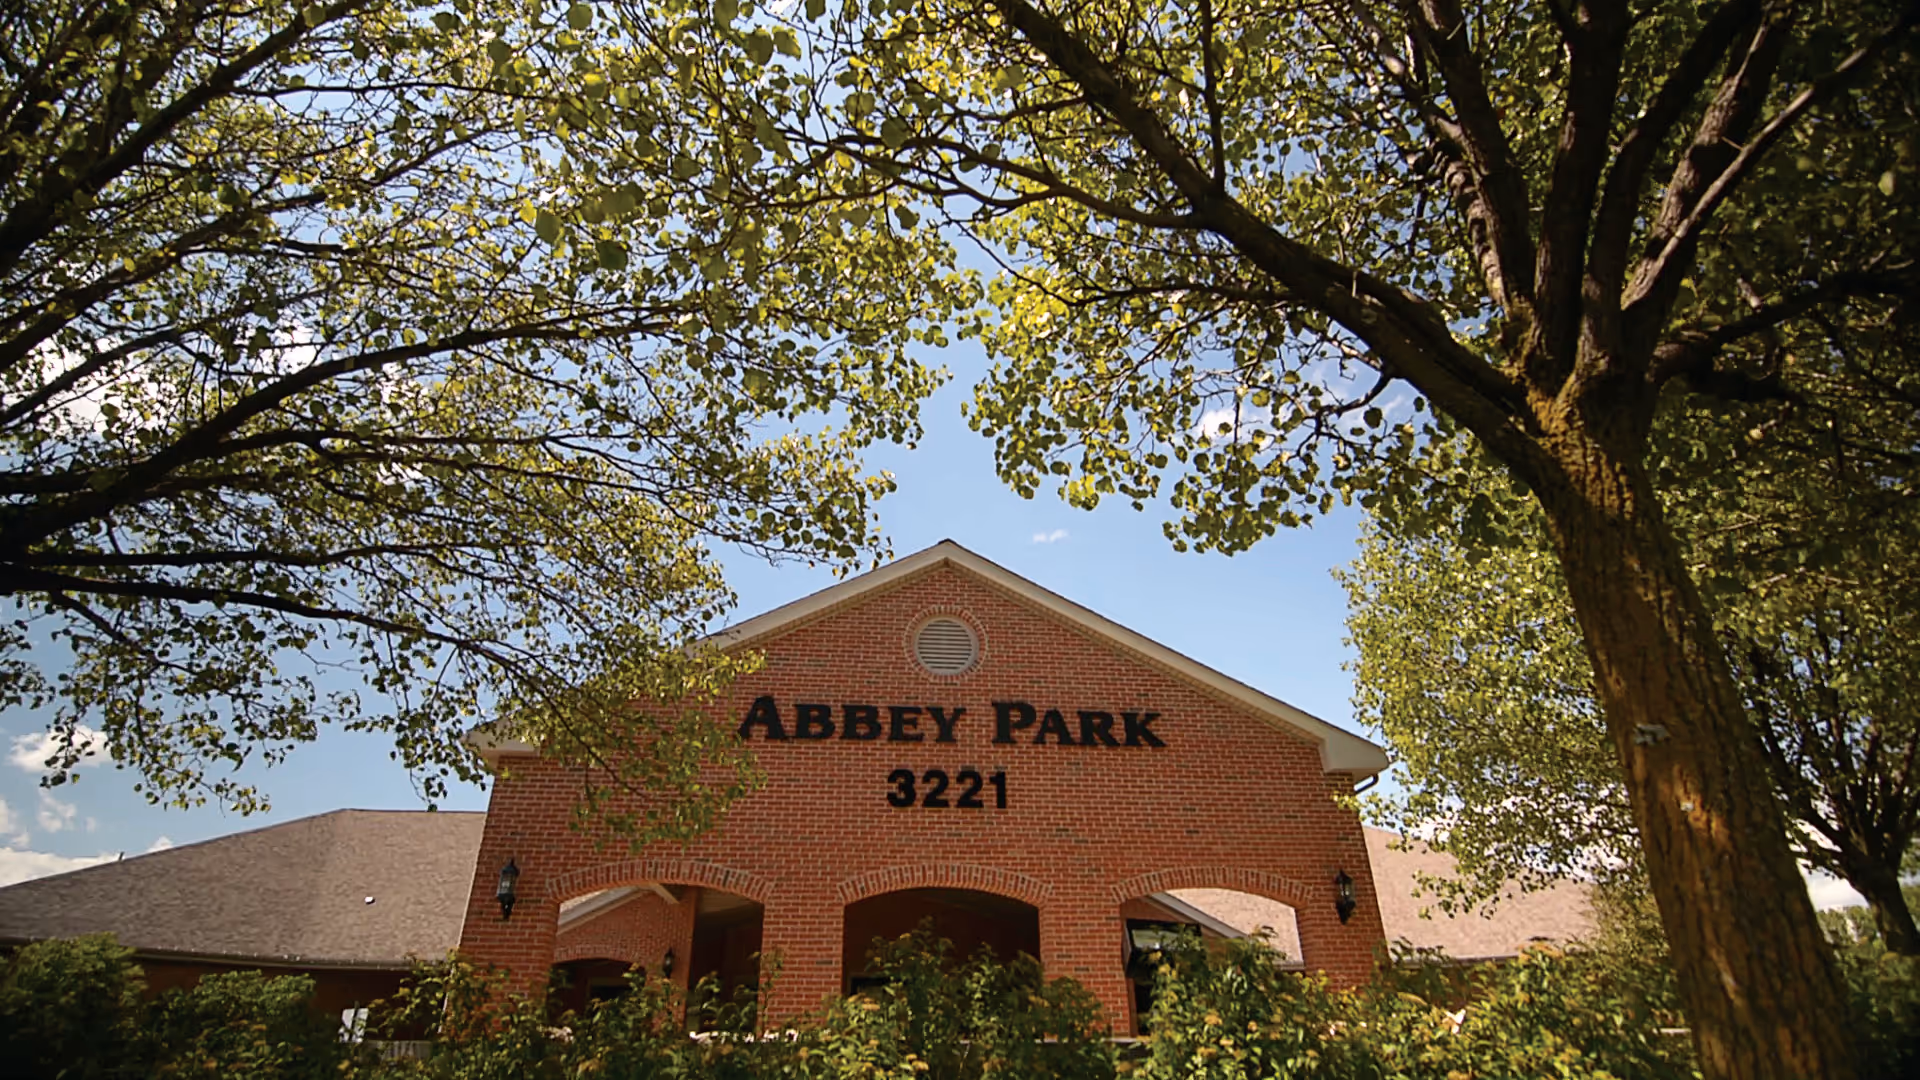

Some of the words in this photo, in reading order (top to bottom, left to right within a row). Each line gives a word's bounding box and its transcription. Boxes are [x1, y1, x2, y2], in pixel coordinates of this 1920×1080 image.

[737, 695, 967, 743] ABBEY
[992, 701, 1167, 748] PARK
[887, 768, 1007, 809] 3221
